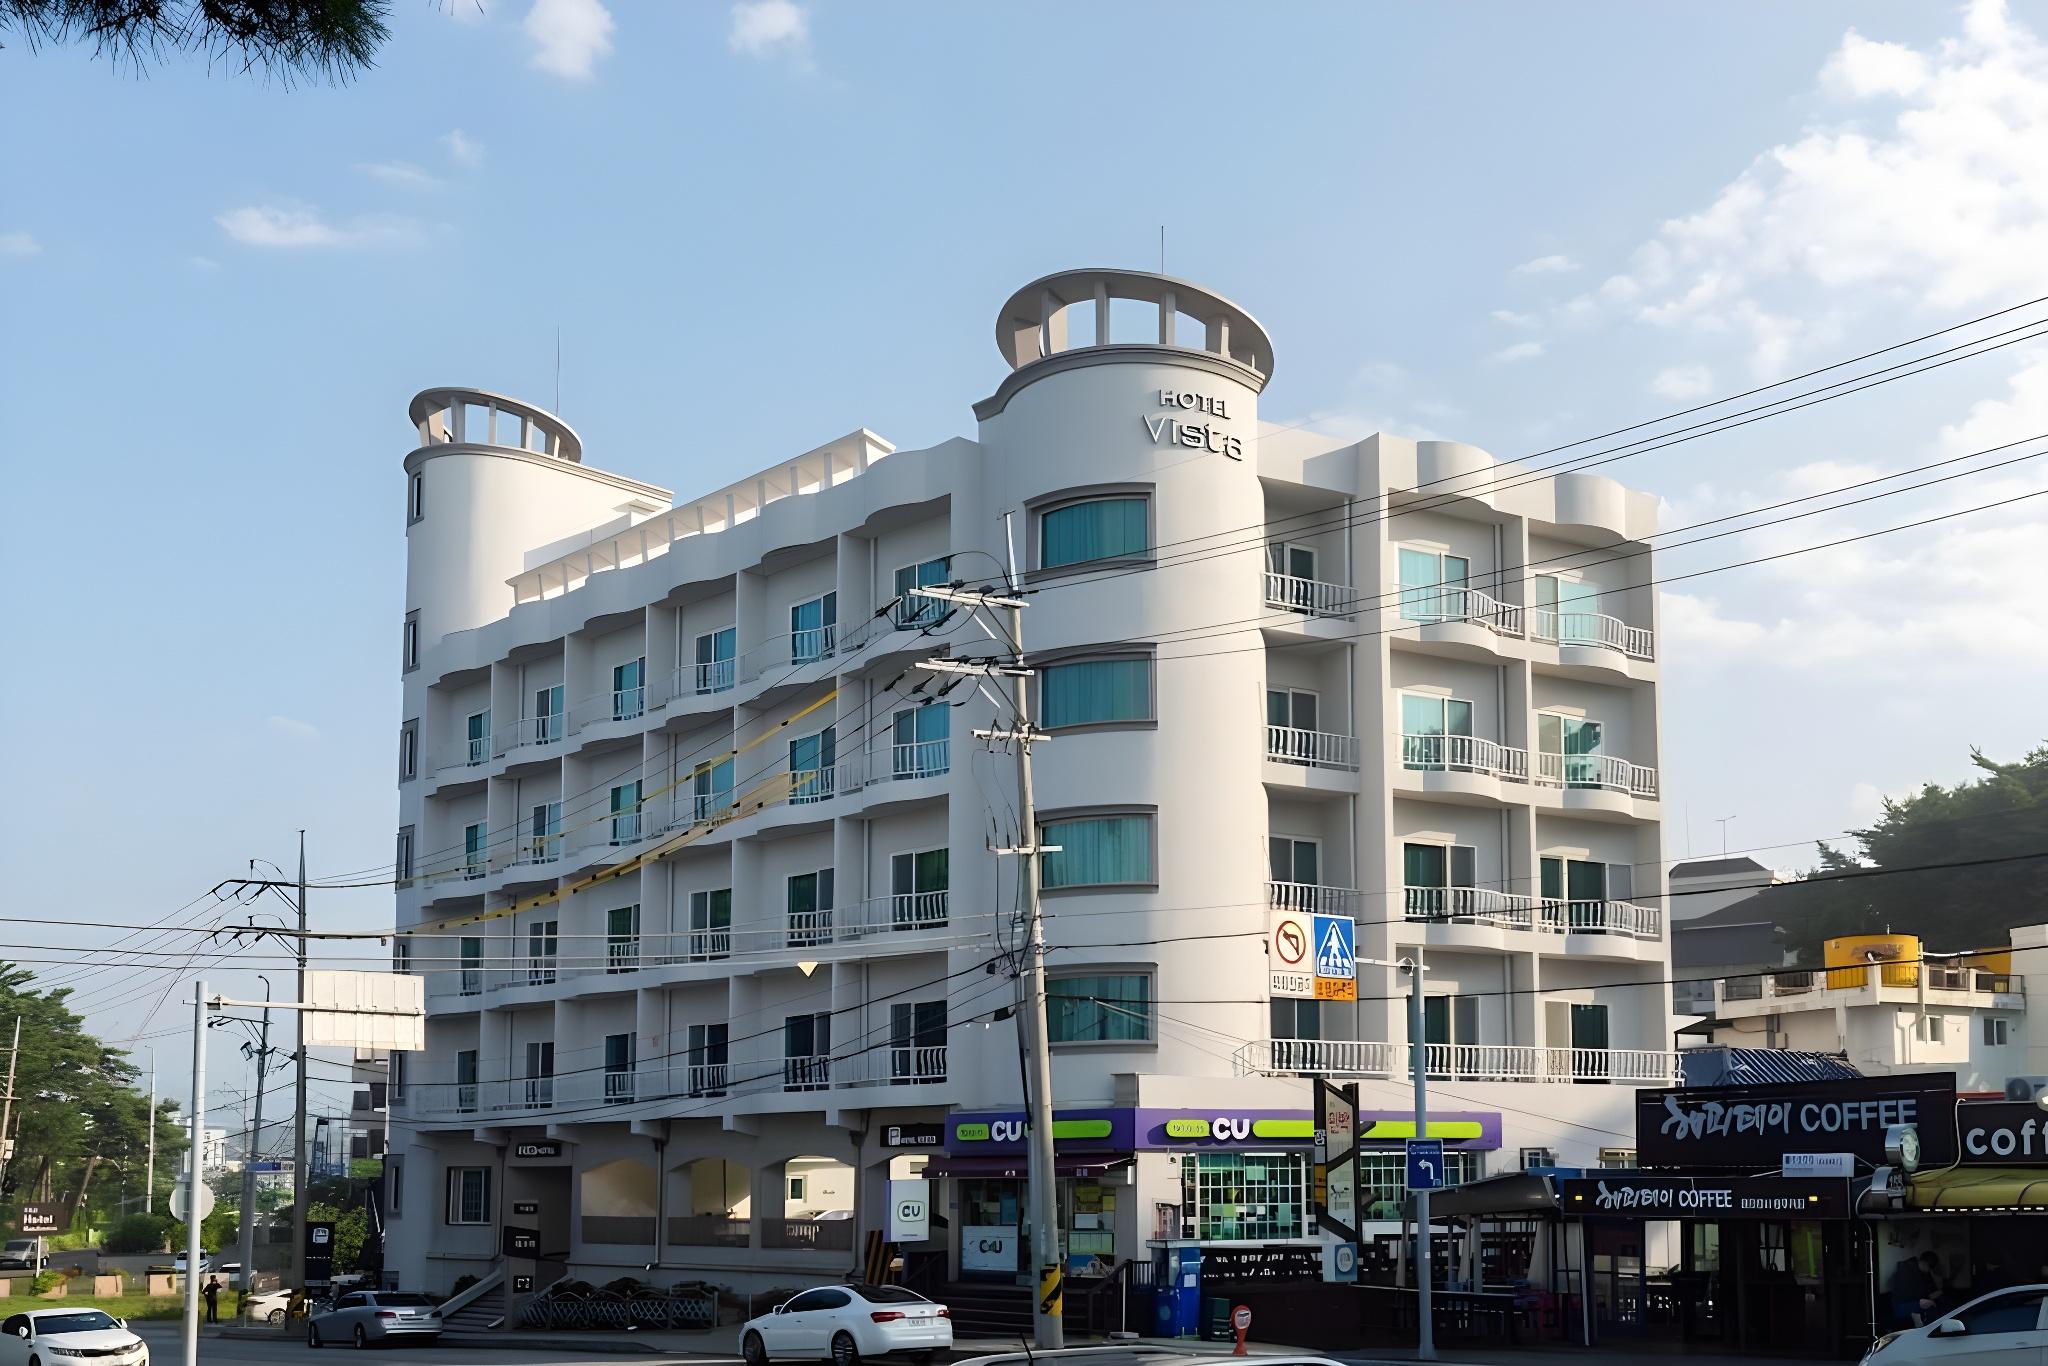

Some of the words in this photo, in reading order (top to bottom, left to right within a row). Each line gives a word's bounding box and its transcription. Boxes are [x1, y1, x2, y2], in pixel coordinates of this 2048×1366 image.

[1159, 389, 1231, 419] HOTEL
[1800, 1099, 1917, 1132] COFFEE
[991, 1121, 1022, 1142] CU
[1212, 1117, 1250, 1140] CU
[1679, 1189, 1732, 1208] COFFEE
[902, 1205, 920, 1218] CU
